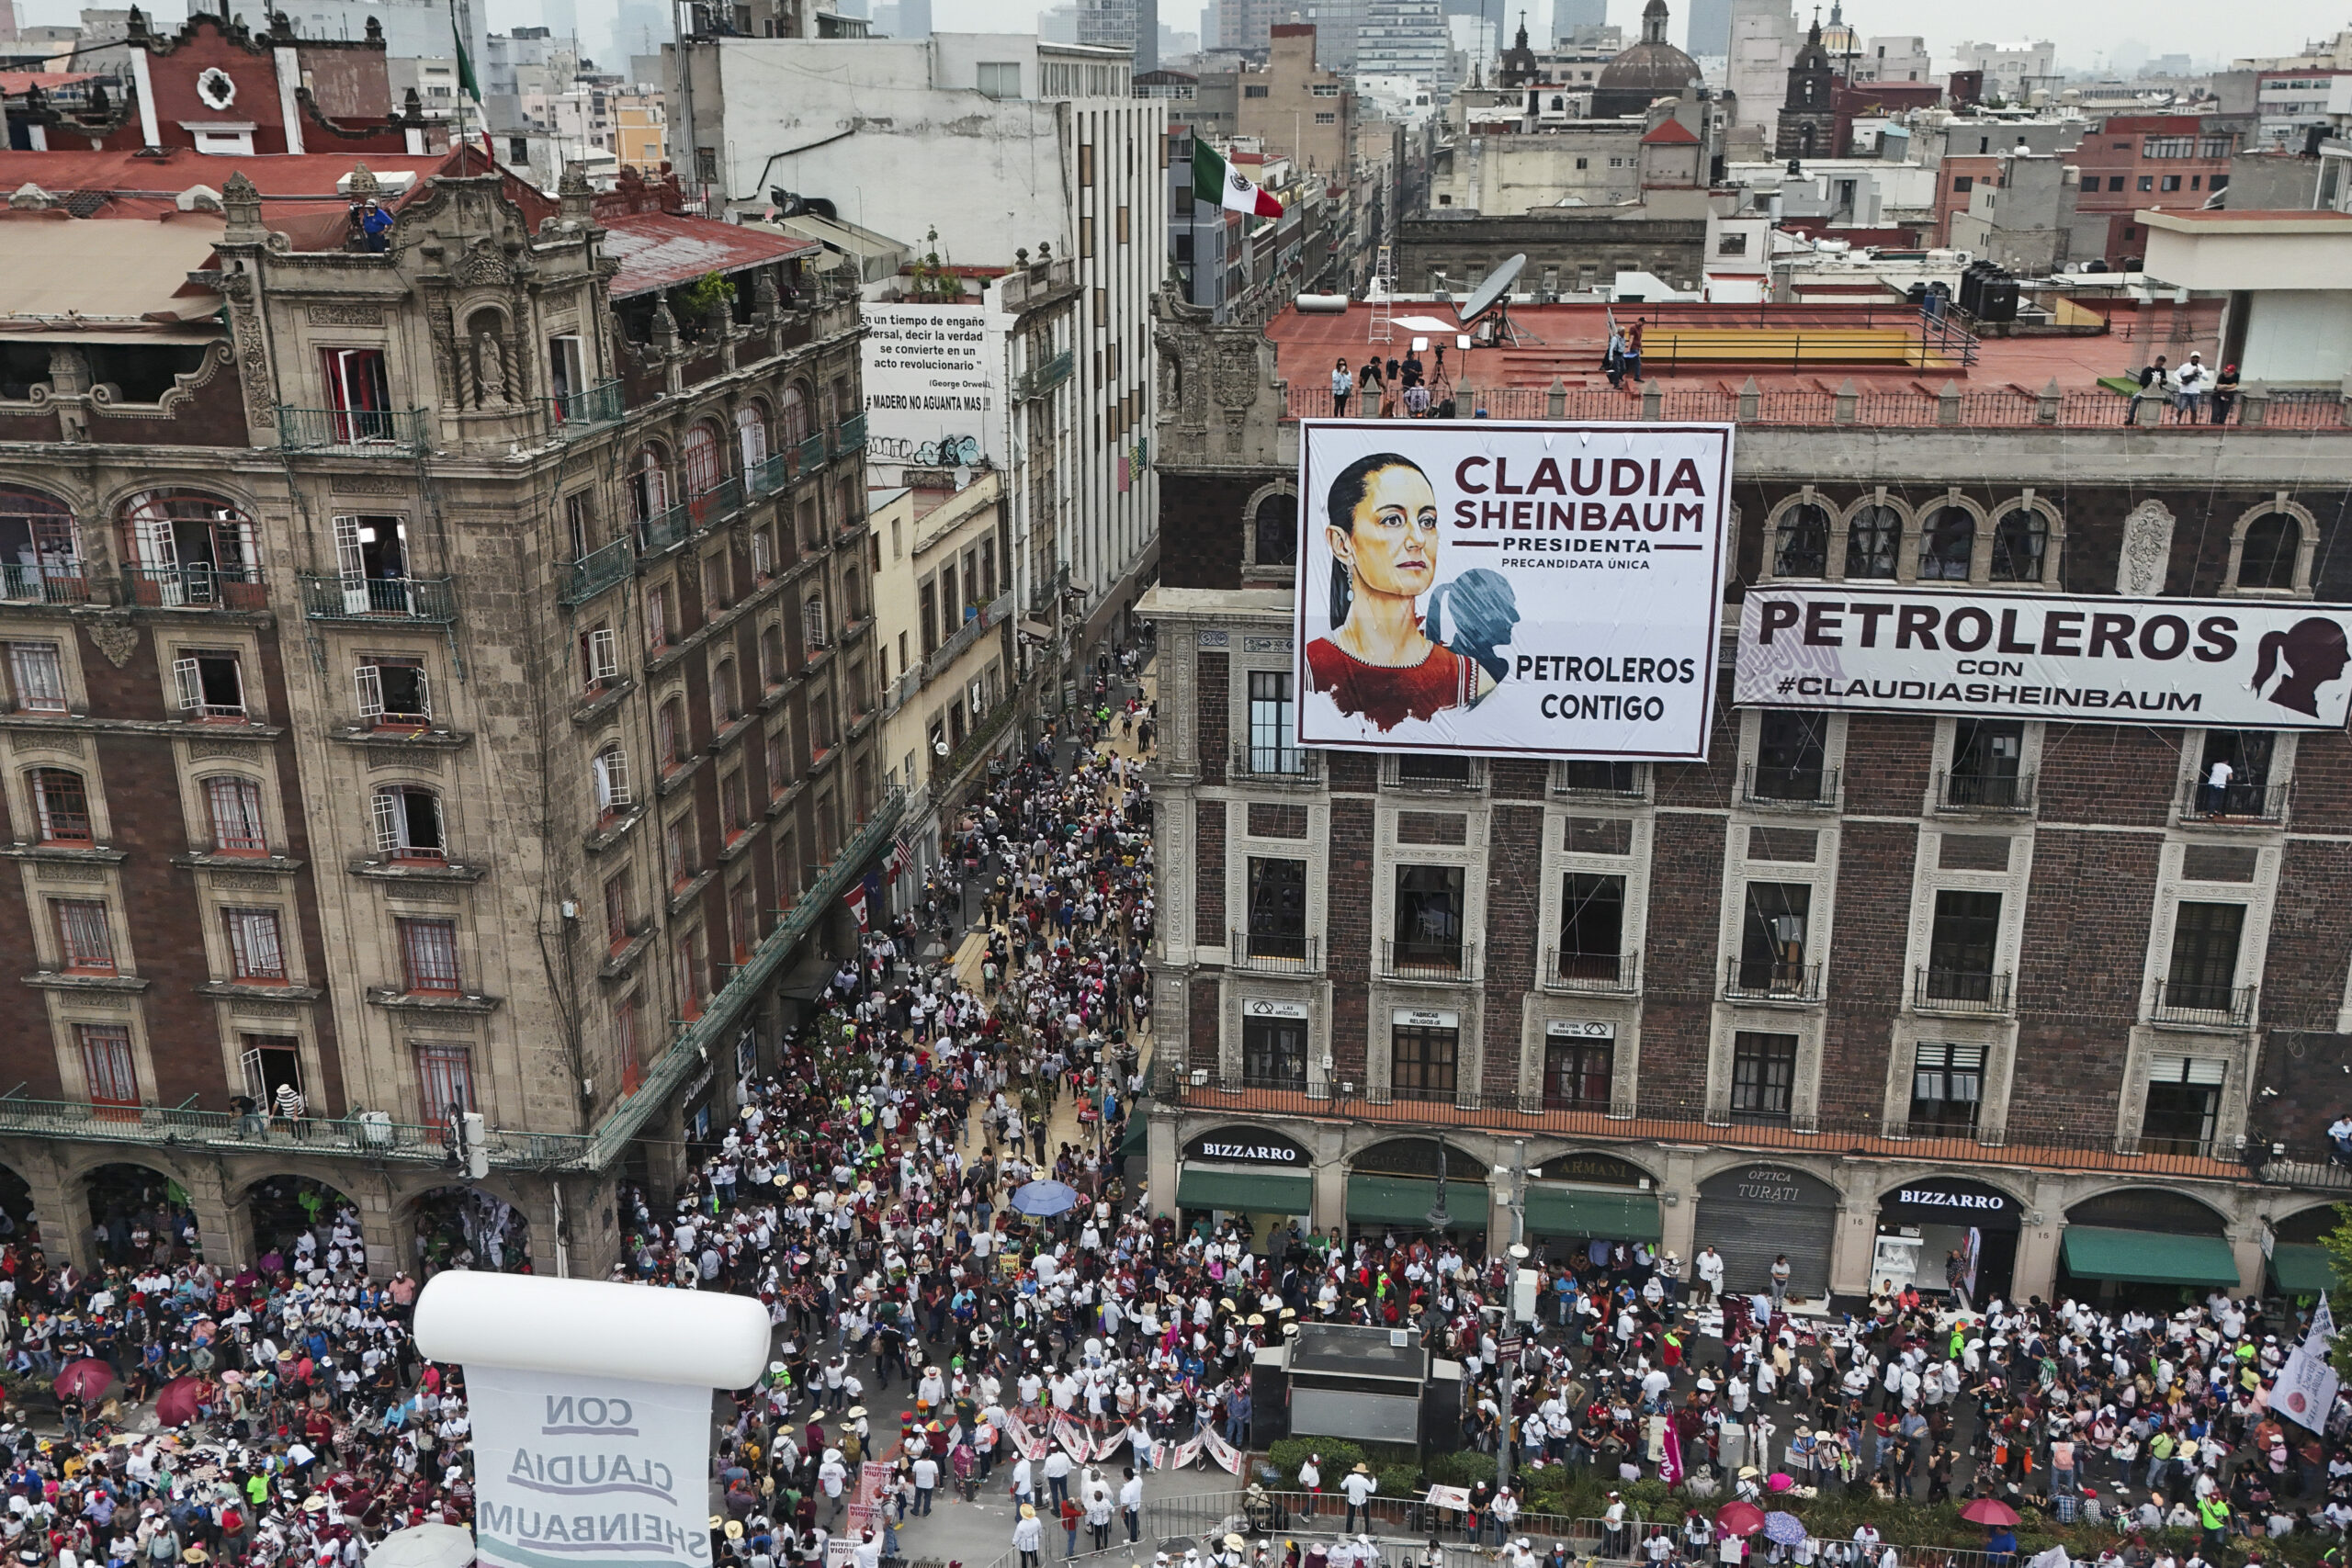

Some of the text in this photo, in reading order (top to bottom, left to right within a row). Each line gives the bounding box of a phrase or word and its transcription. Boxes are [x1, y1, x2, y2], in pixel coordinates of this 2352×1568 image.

[875, 315, 887, 324] un
[890, 314, 927, 328] tiempo
[931, 315, 944, 326] de
[946, 315, 985, 329] engaño
[868, 330, 983, 342] versal, decir la verdad
[880, 344, 976, 355] se convierte en un
[874, 359, 897, 368] acto
[900, 359, 974, 370] revolucionario
[929, 379, 960, 389] (George
[874, 395, 908, 410] MADERO
[910, 396, 921, 410] NO
[923, 396, 962, 411] AGUANTA
[964, 397, 981, 412] MAS
[1455, 456, 1705, 497] CLAUDIA
[1453, 501, 1703, 533] SHEINBAUM
[1503, 537, 1651, 554] PRESIDENTA
[1501, 557, 1650, 570] PRECANDIDATA ÚNICA
[1758, 601, 2239, 663] PETROLEROS
[1515, 654, 1695, 684] PETROLEROS
[1956, 659, 2023, 677] CON
[1776, 676, 2202, 714] #CLAUDIASHEINBAUM
[1541, 694, 1665, 721] CONTIGO
[1203, 1143, 1296, 1161] BIZZARRO
[1559, 1160, 1627, 1178] ARMANI
[1748, 1170, 1792, 1182] OPTICA
[1738, 1184, 1800, 1201] TURATI
[1899, 1190, 2004, 1210] BIZZARRO
[865, 1471, 891, 1479] LAUDIA
